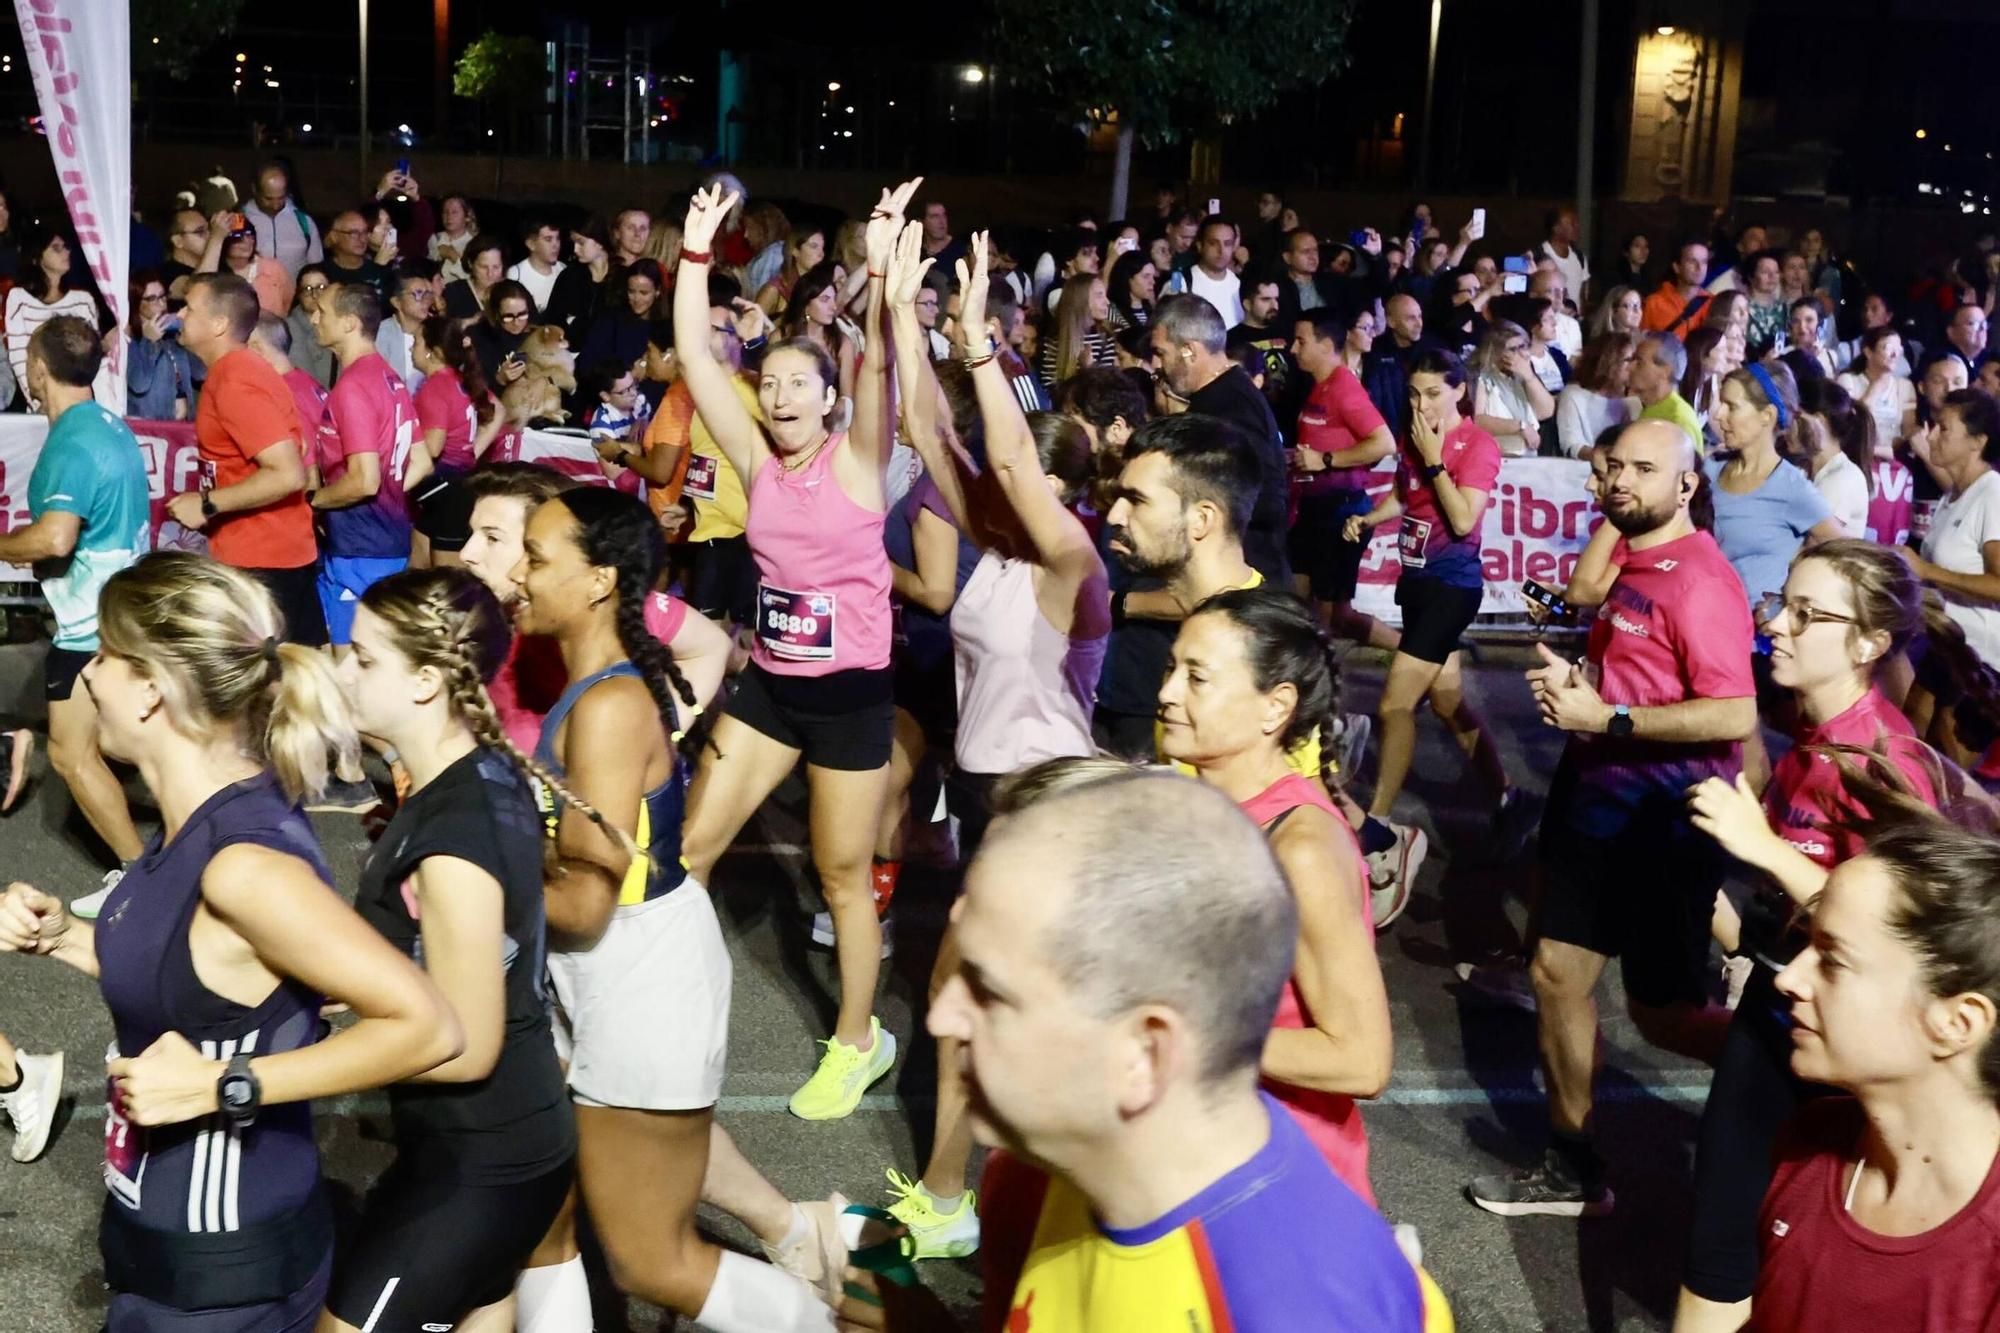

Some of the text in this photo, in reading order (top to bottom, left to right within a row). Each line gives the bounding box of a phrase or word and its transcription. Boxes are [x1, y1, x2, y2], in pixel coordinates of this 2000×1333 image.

[1487, 482, 1605, 539] ibr
[1481, 540, 1580, 585] alen
[768, 610, 818, 636] 8880
